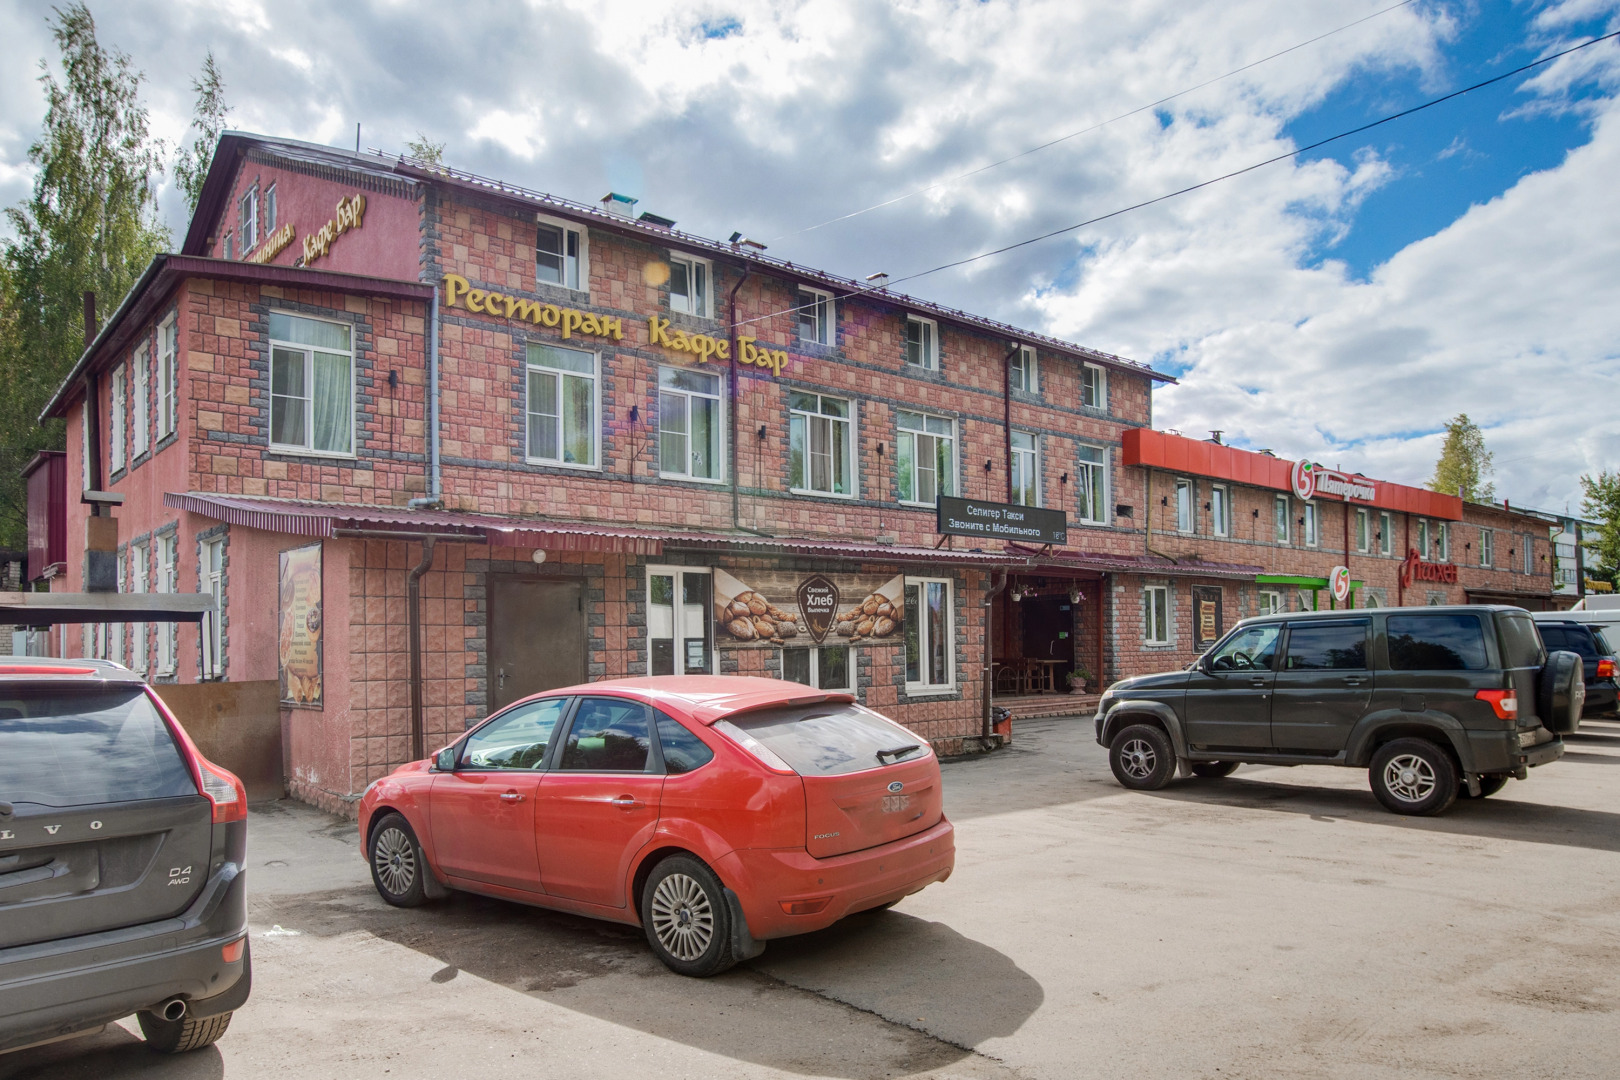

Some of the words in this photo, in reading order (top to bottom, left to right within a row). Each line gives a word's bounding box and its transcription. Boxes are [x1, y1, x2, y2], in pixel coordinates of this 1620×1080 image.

[303, 219, 337, 266] Кафе
[336, 193, 366, 233] Бар
[442, 273, 623, 341] Ресторан
[648, 315, 729, 364] Кафе
[736, 335, 789, 377] Бар
[1314, 471, 1376, 502] Пятерочка
[1002, 509, 1025, 521] Такси
[948, 518, 984, 531] Звоните
[985, 523, 991, 532] с
[992, 523, 1041, 537] Мобильного
[806, 594, 833, 606] Хлеб
[814, 831, 840, 840] FOCUS
[169, 866, 192, 878] D4
[168, 877, 190, 886] AWD
